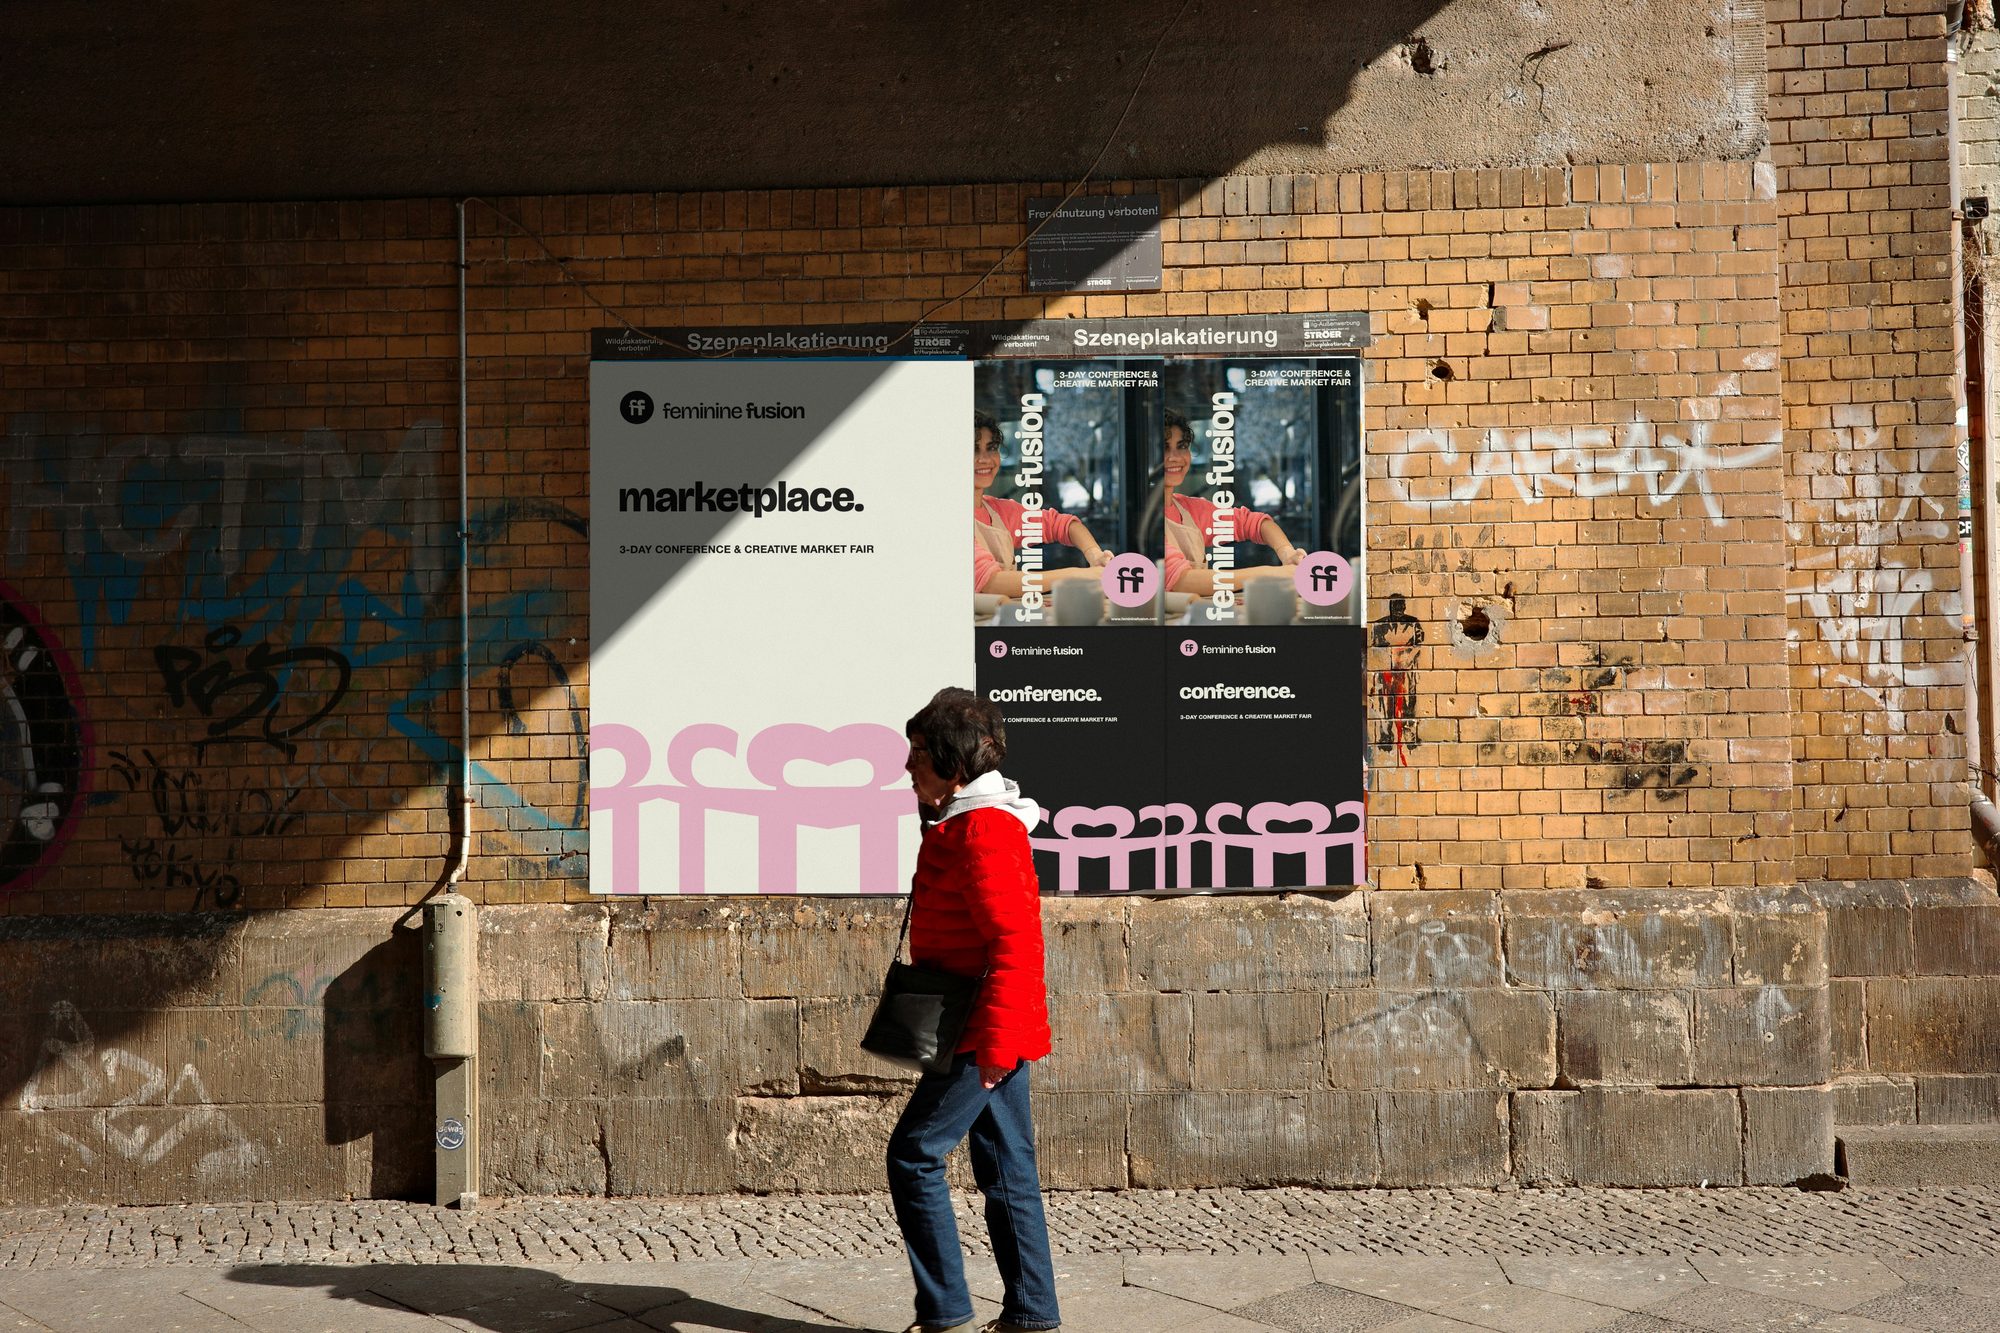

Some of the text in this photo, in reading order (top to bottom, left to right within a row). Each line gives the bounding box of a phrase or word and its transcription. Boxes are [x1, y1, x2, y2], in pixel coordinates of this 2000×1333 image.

[1108, 206, 1159, 217] verboten!
[991, 333, 1050, 342] Wildplakatierung
[1073, 327, 1279, 349] Szeneplakatierung
[1303, 330, 1342, 339] STRÖER
[687, 331, 889, 354] Szeneplakatierung
[913, 338, 952, 347] STRÖER
[1059, 371, 1159, 379] 3-DAY CONFERENCE &
[1251, 370, 1352, 378] 3-DAY CONFERENCE &
[1053, 380, 1097, 388] CREATIVE
[1098, 380, 1137, 388] MARKET
[1244, 378, 1352, 387] CREATIVE MARKET FAIR
[662, 402, 806, 420] feminine fusion
[619, 481, 865, 518] marketplace.
[1014, 393, 1044, 623] feminine fusion
[1205, 391, 1235, 621] feminine fusion
[619, 545, 875, 554] 3-DAY CONFERENCE & CREATIVE MARKET FAIR
[1011, 645, 1084, 656] feminine fusion
[1202, 644, 1276, 654] feminine fusion
[989, 685, 1103, 702] conference.
[1179, 682, 1296, 699] conference.
